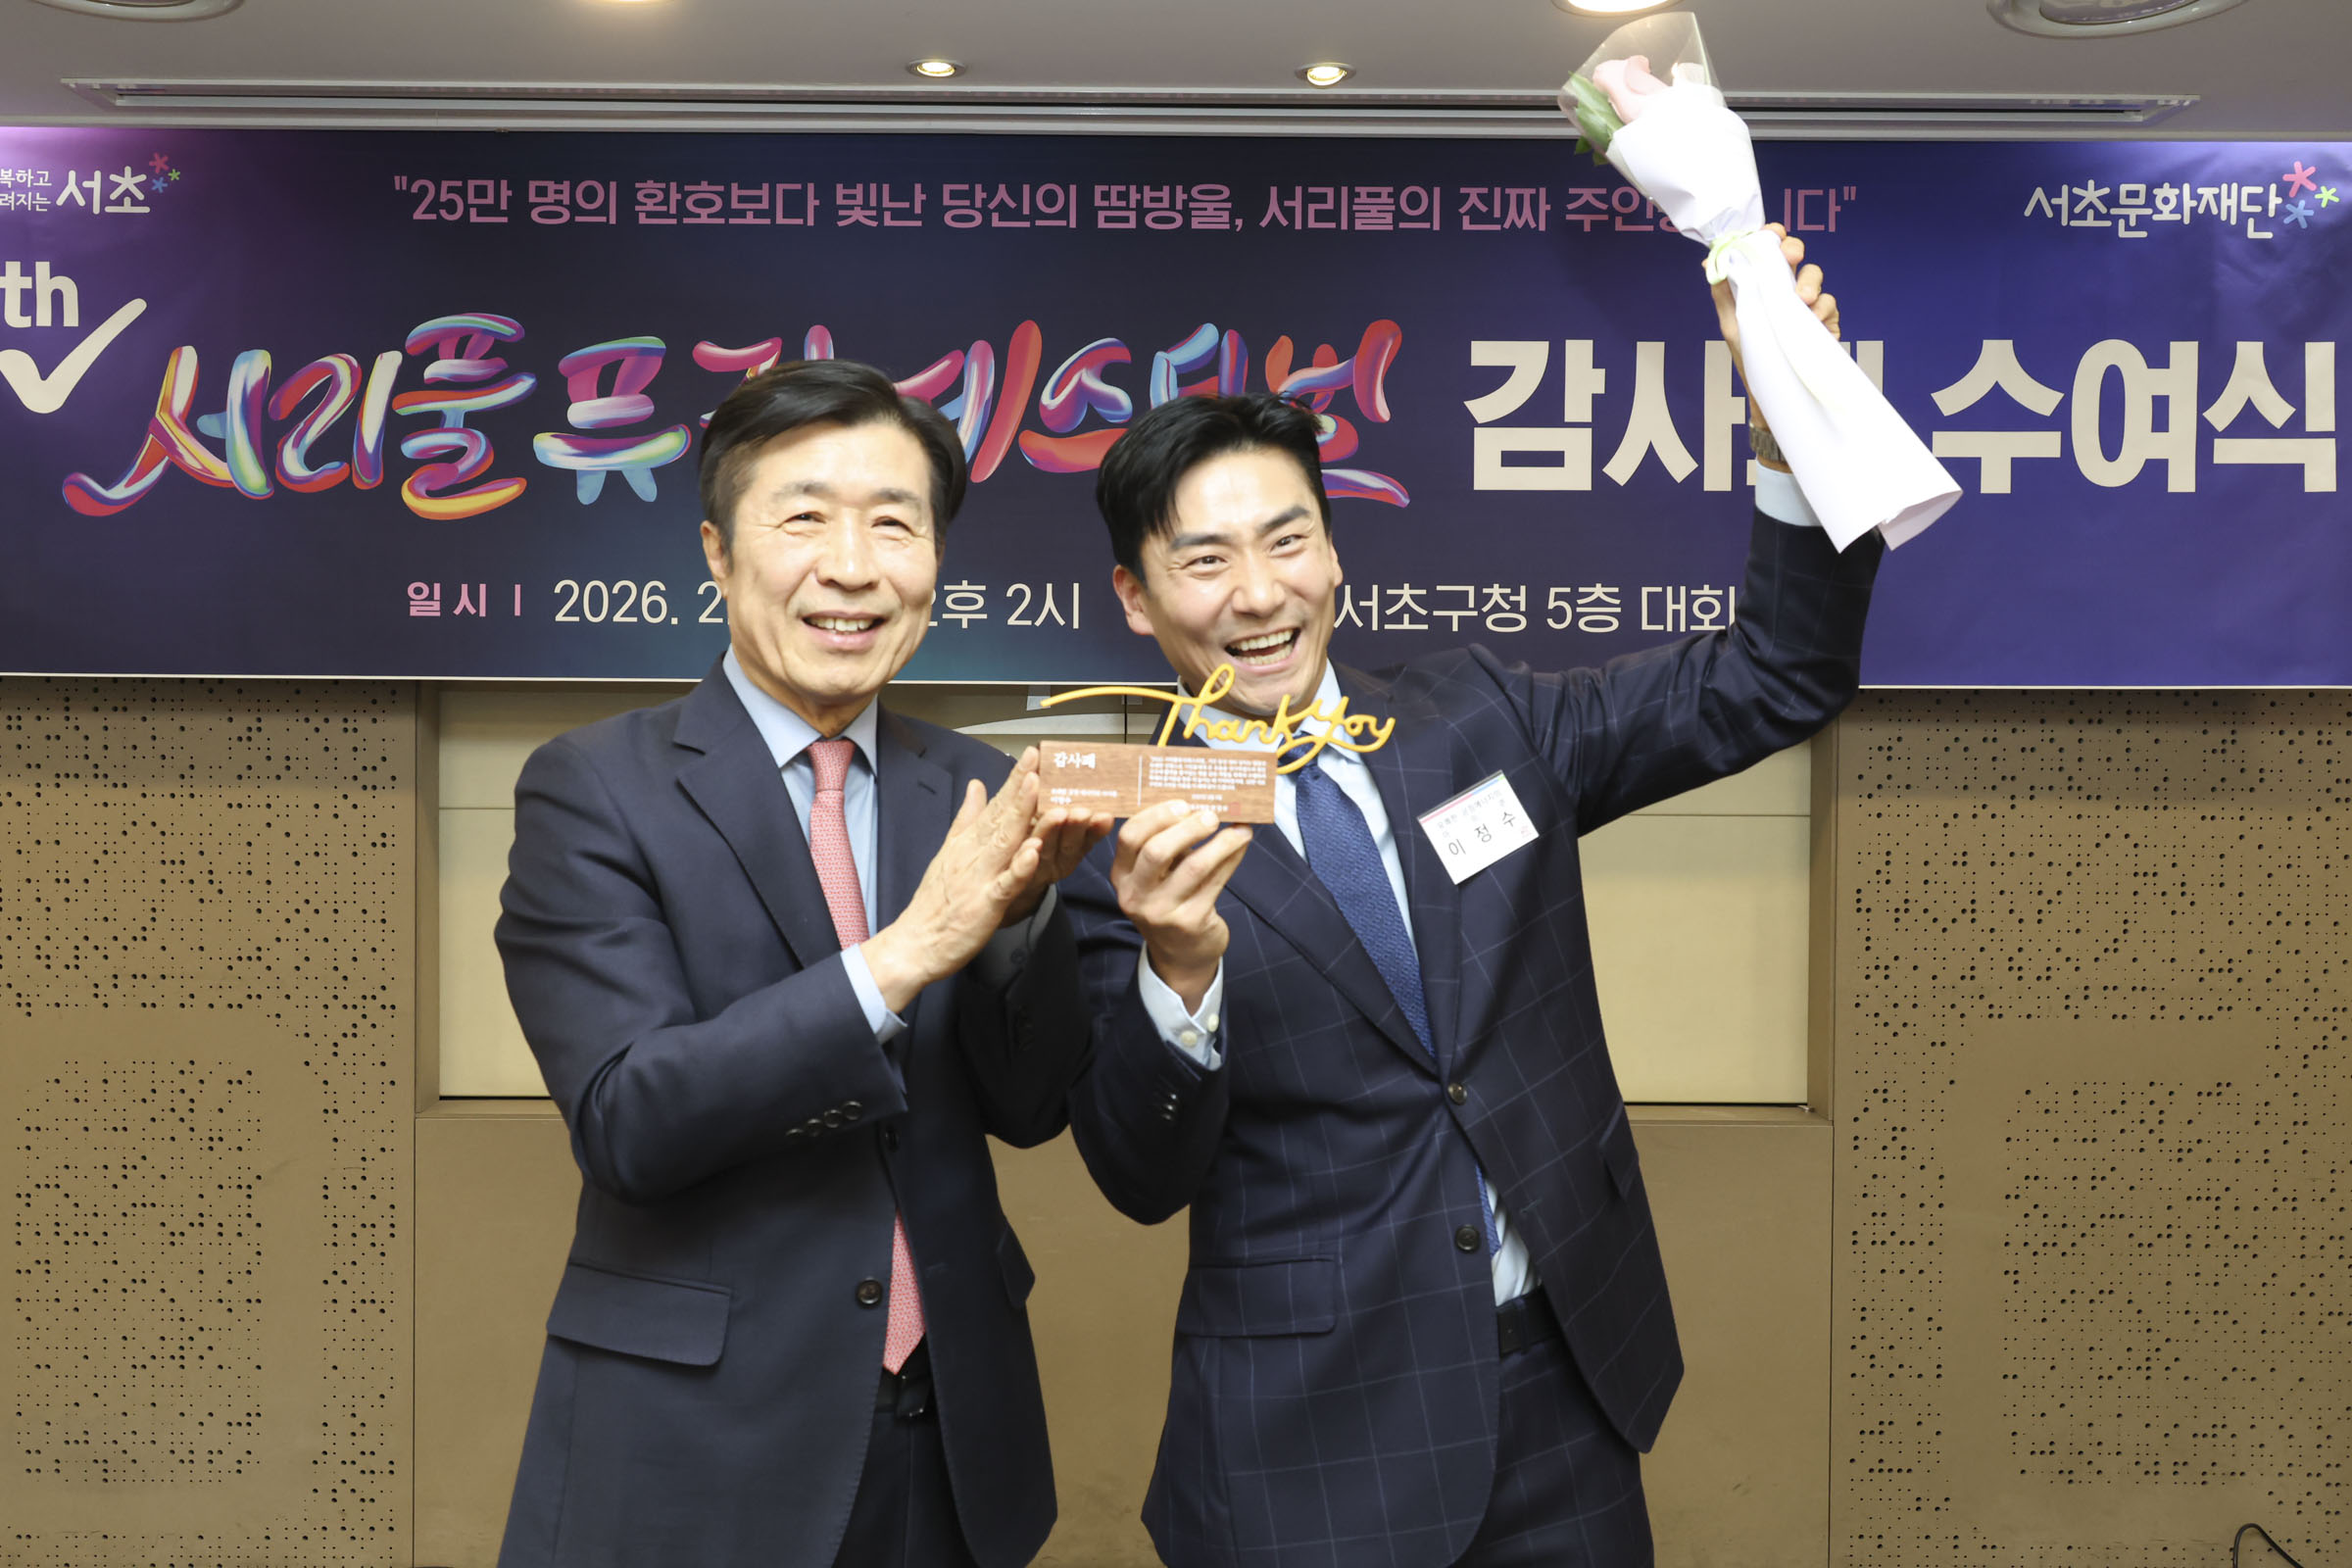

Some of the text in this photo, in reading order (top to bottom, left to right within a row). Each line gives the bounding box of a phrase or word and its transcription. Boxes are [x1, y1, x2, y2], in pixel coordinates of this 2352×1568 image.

[56, 166, 151, 215] 서초
[394, 175, 513, 224] "25만
[528, 180, 616, 225] 명의
[634, 180, 819, 227] 환호보다
[835, 182, 927, 228] 빛난
[942, 183, 1078, 229] 당신의
[1094, 184, 1244, 232] 땀방울,
[1259, 185, 1442, 231] 서리풀의
[1458, 186, 1551, 232] 진짜
[2025, 179, 2283, 239] 서초문화재단
[1464, 339, 1884, 492] 감사
[1931, 339, 2337, 493] 수여식
[407, 581, 487, 617] 일시
[554, 579, 679, 625] 2026.
[1006, 582, 1081, 630] 2시
[1333, 583, 1529, 633] 서초구청
[1546, 583, 1623, 633] 5층
[1054, 752, 1097, 769] 감사패
